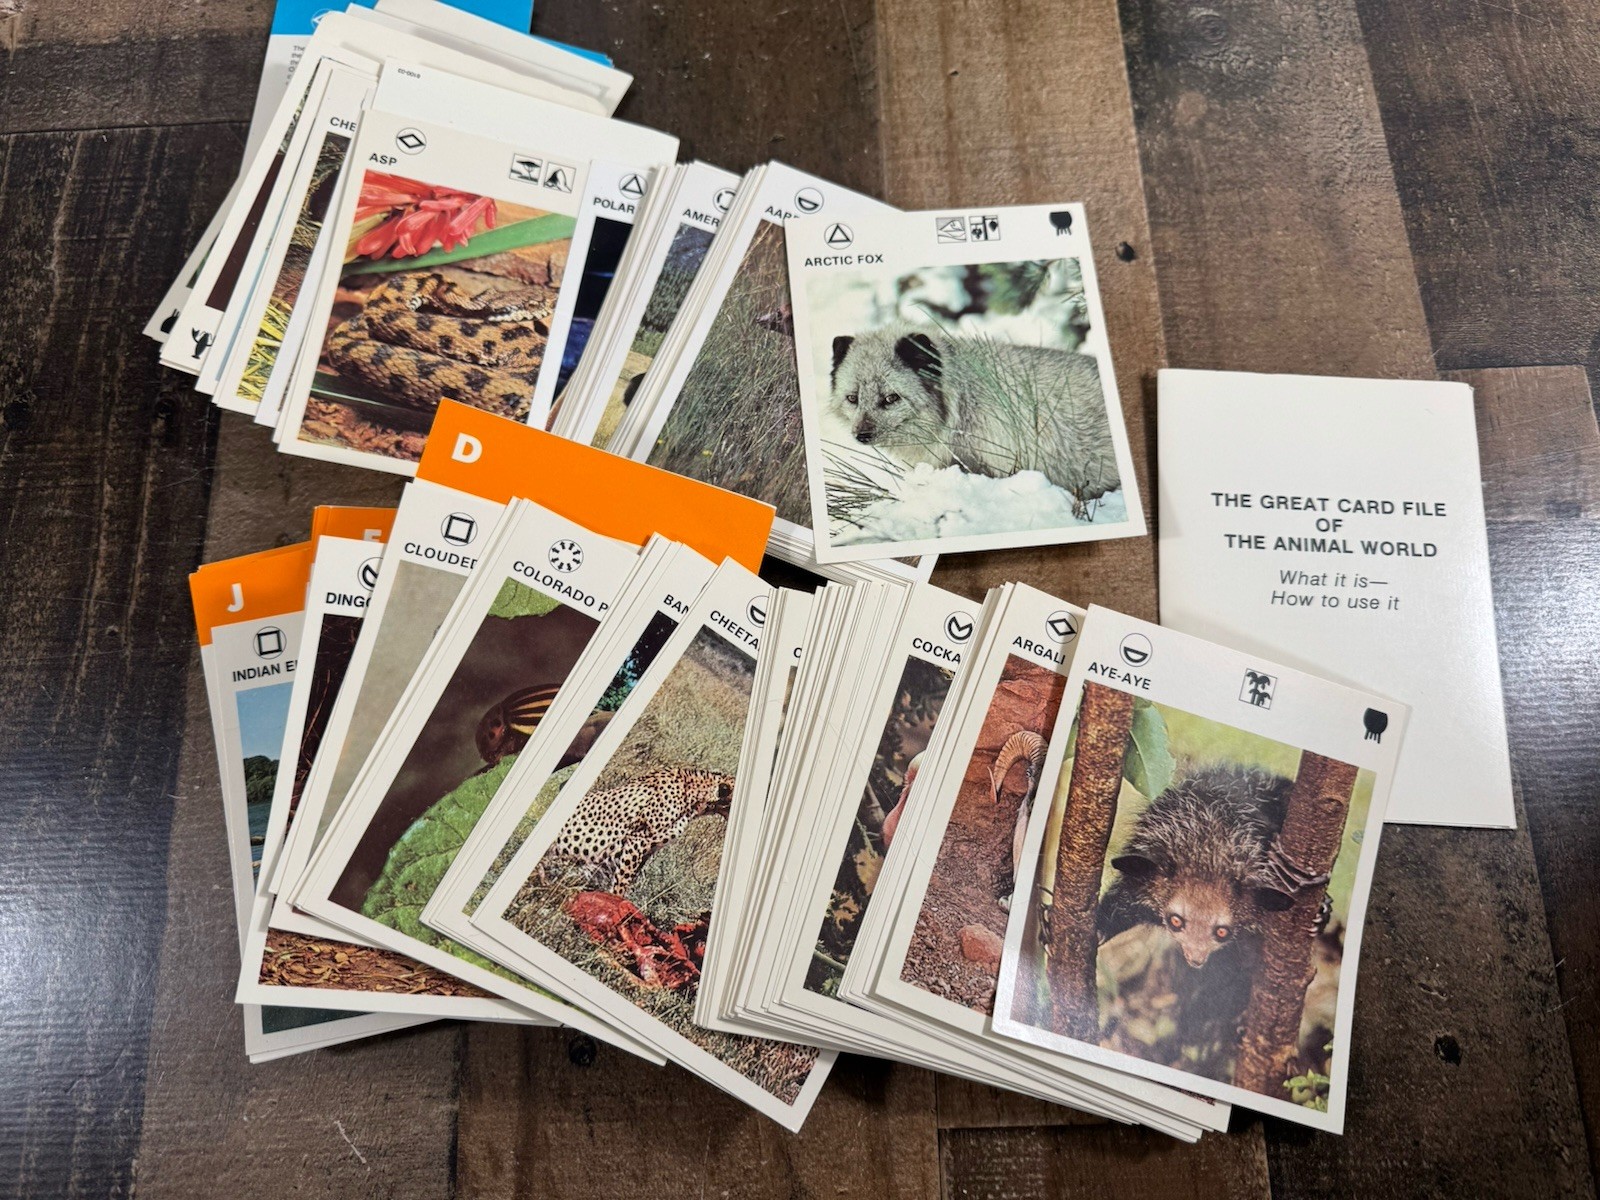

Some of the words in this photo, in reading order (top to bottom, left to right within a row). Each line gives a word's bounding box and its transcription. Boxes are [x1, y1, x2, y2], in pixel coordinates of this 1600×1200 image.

[329, 116, 357, 132] CHE
[369, 153, 398, 166] ASP
[593, 197, 635, 214] POLAR
[682, 208, 721, 228] AMER
[804, 255, 853, 267] ARCTIC
[858, 253, 884, 264] FOX
[451, 432, 483, 464] D
[1211, 492, 1251, 508] THE
[1260, 494, 1329, 512] GREAT
[1337, 498, 1395, 515] CARD
[1402, 501, 1447, 517] FILE
[1315, 518, 1343, 533] OF
[1224, 533, 1265, 549] THE
[1273, 536, 1354, 554] ANIMAL
[1360, 540, 1438, 557] WORLD
[512, 560, 595, 608] COLORADO
[598, 602, 609, 613] P
[1279, 569, 1327, 586] What
[1334, 572, 1347, 587] it
[227, 582, 244, 612] J
[1270, 590, 1313, 607] How
[1321, 594, 1340, 608] to
[1347, 597, 1380, 609] use
[1387, 596, 1400, 611] it
[912, 637, 962, 665] COCKA
[1012, 635, 1066, 665] ARGALI
[233, 663, 281, 682] INDIAN
[1088, 661, 1152, 690] AYE-AYE
